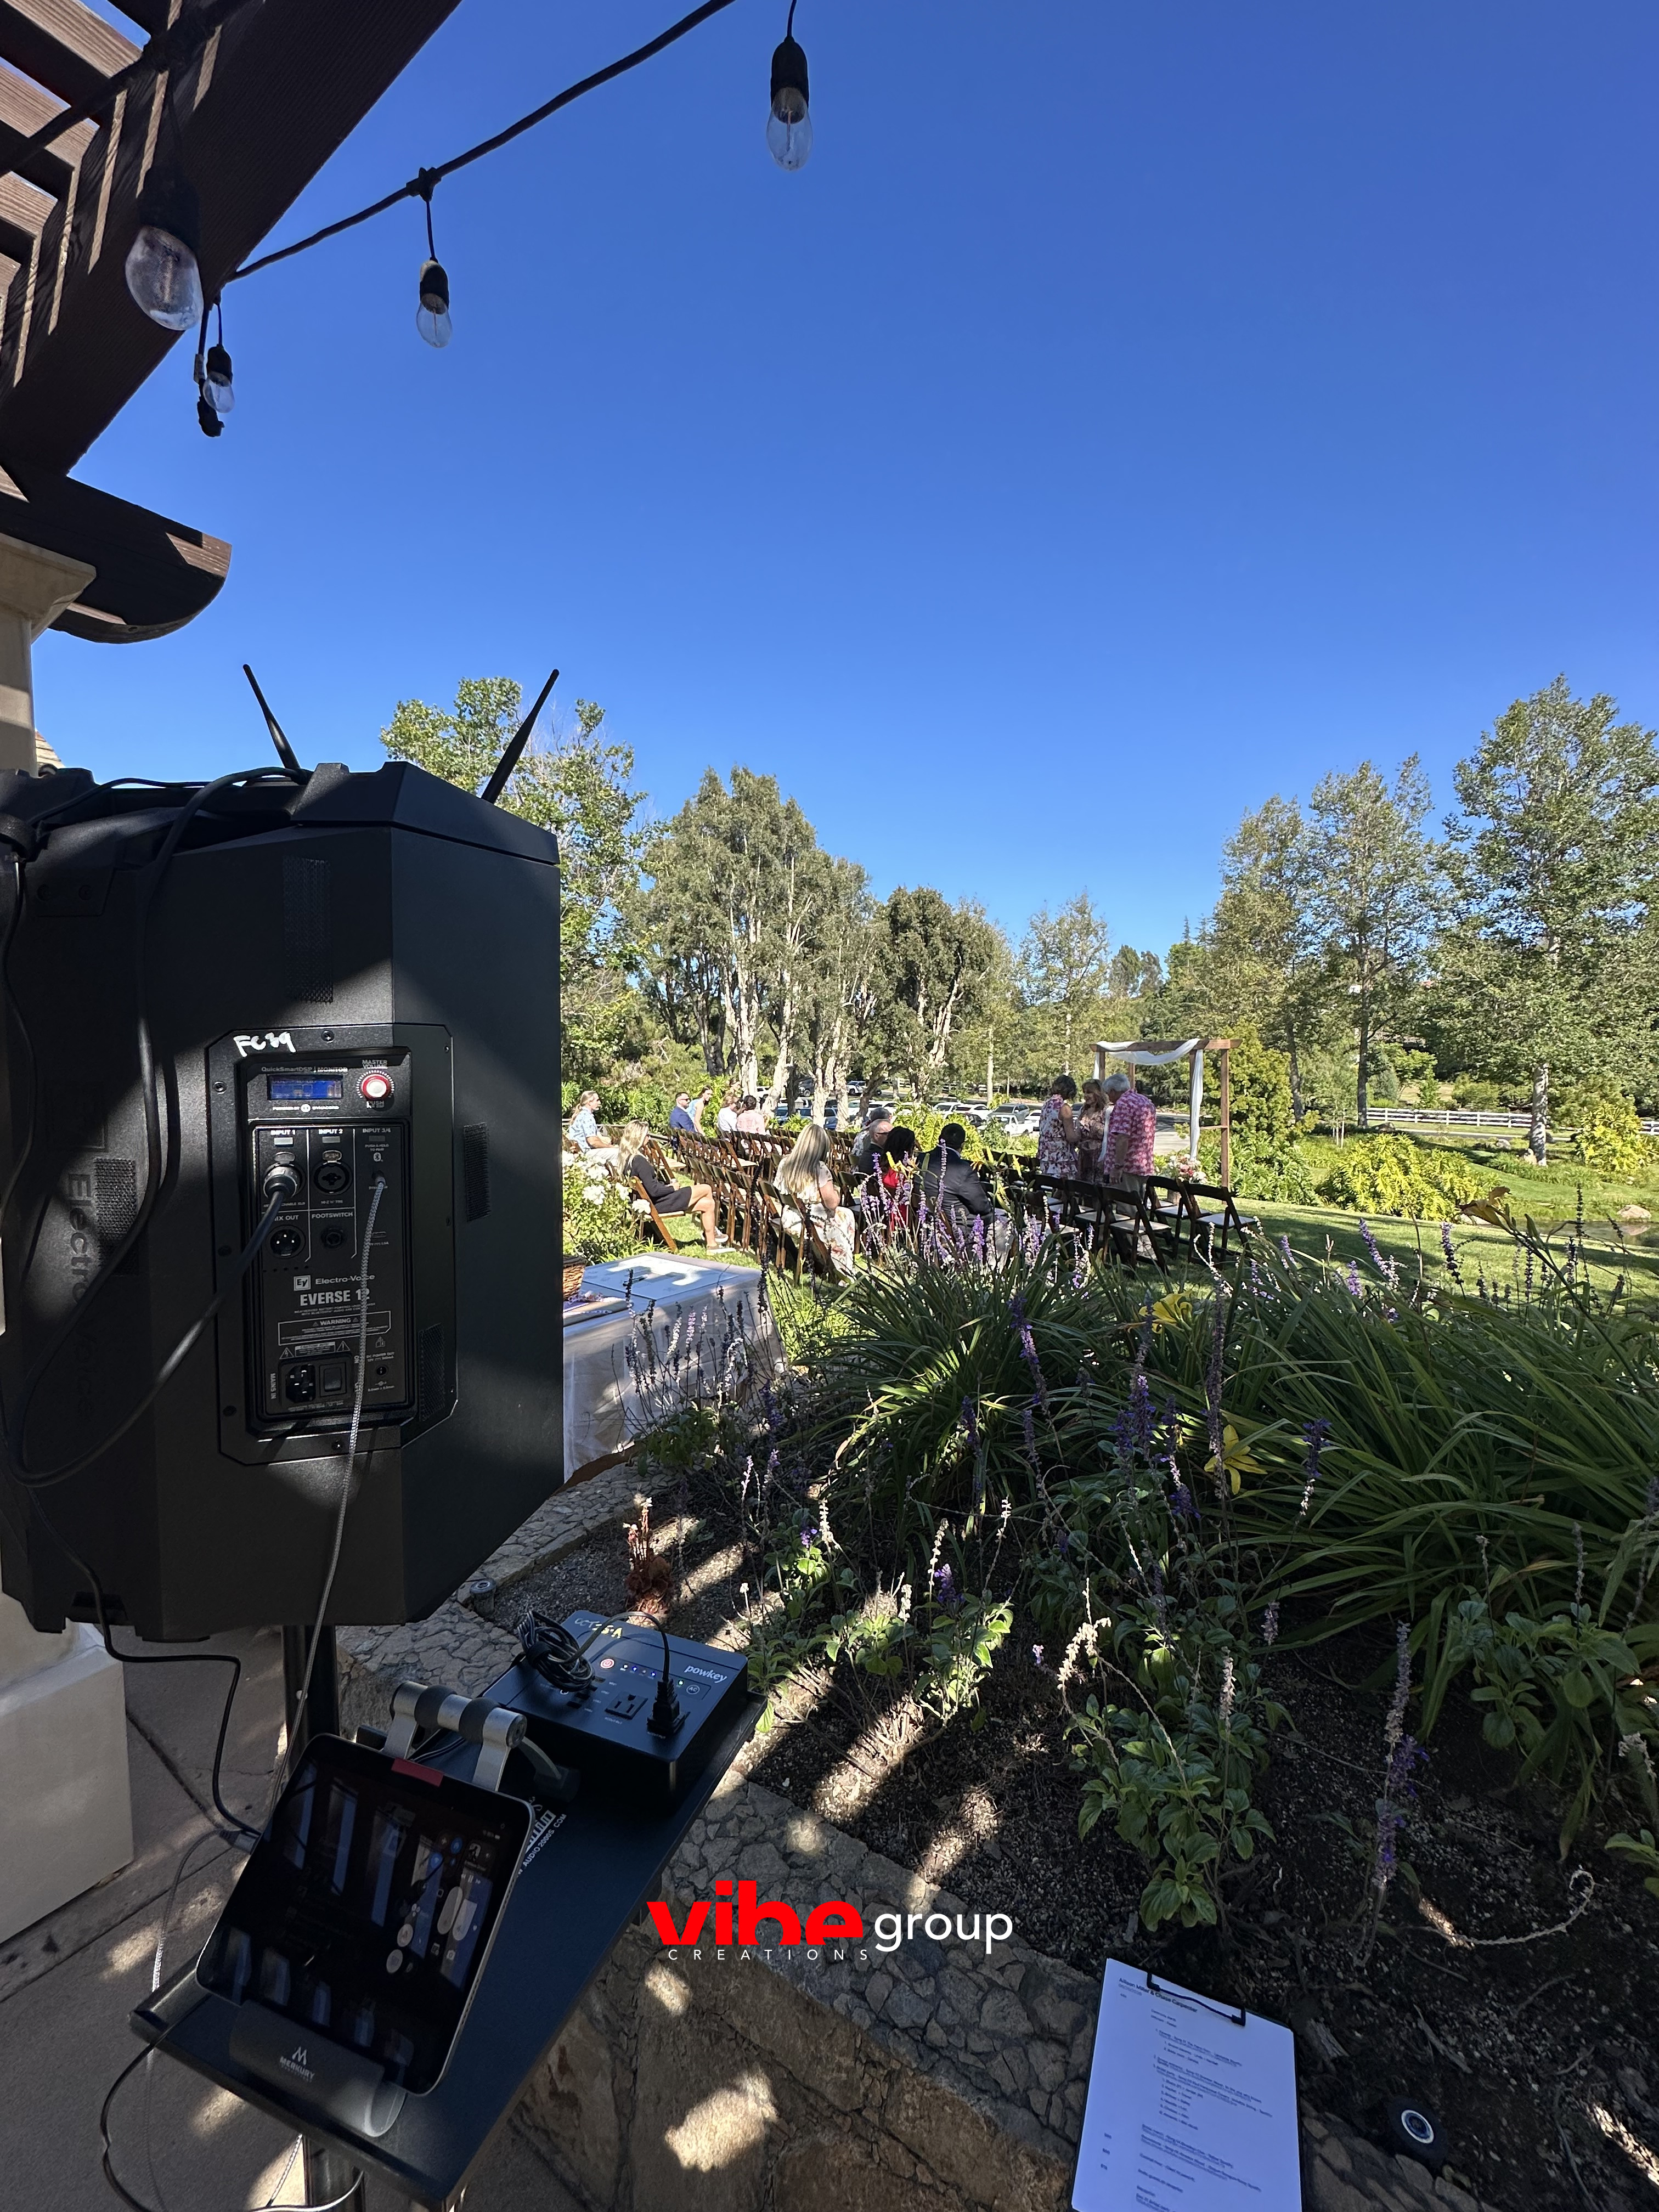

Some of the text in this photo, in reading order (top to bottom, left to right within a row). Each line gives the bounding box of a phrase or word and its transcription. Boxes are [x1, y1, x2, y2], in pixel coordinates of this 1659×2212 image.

[315, 1274, 376, 1285] Electro-Voe
[300, 1290, 351, 1306] EVERSE
[319, 1318, 352, 1326] WARNING
[684, 1664, 728, 1684] powkey
[279, 2055, 315, 2081] MERKURY
